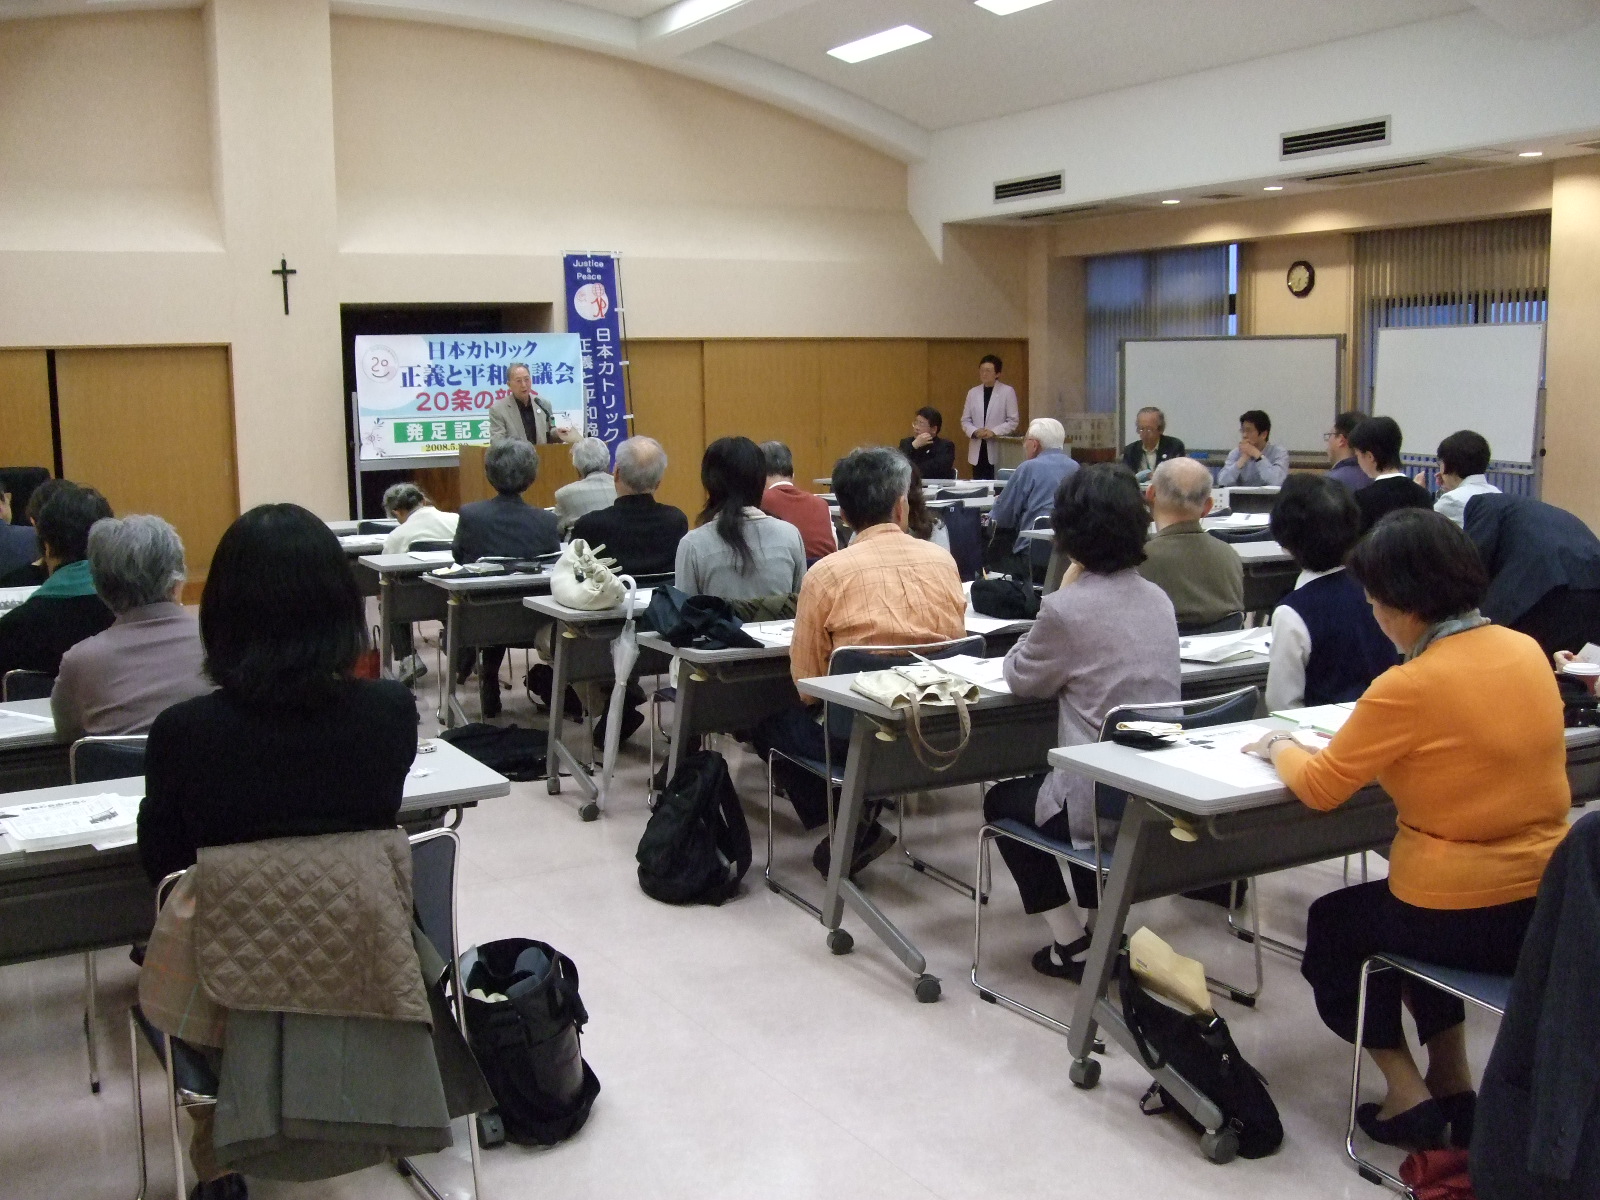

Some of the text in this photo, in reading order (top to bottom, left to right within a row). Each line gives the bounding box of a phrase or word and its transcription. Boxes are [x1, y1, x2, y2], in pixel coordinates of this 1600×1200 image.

[573, 259, 604, 267] Justice
[576, 272, 602, 280] Peace
[428, 340, 538, 360] 日本カトリック
[399, 361, 575, 388] 正義と平和議会
[596, 328, 619, 443] 日本カトリック
